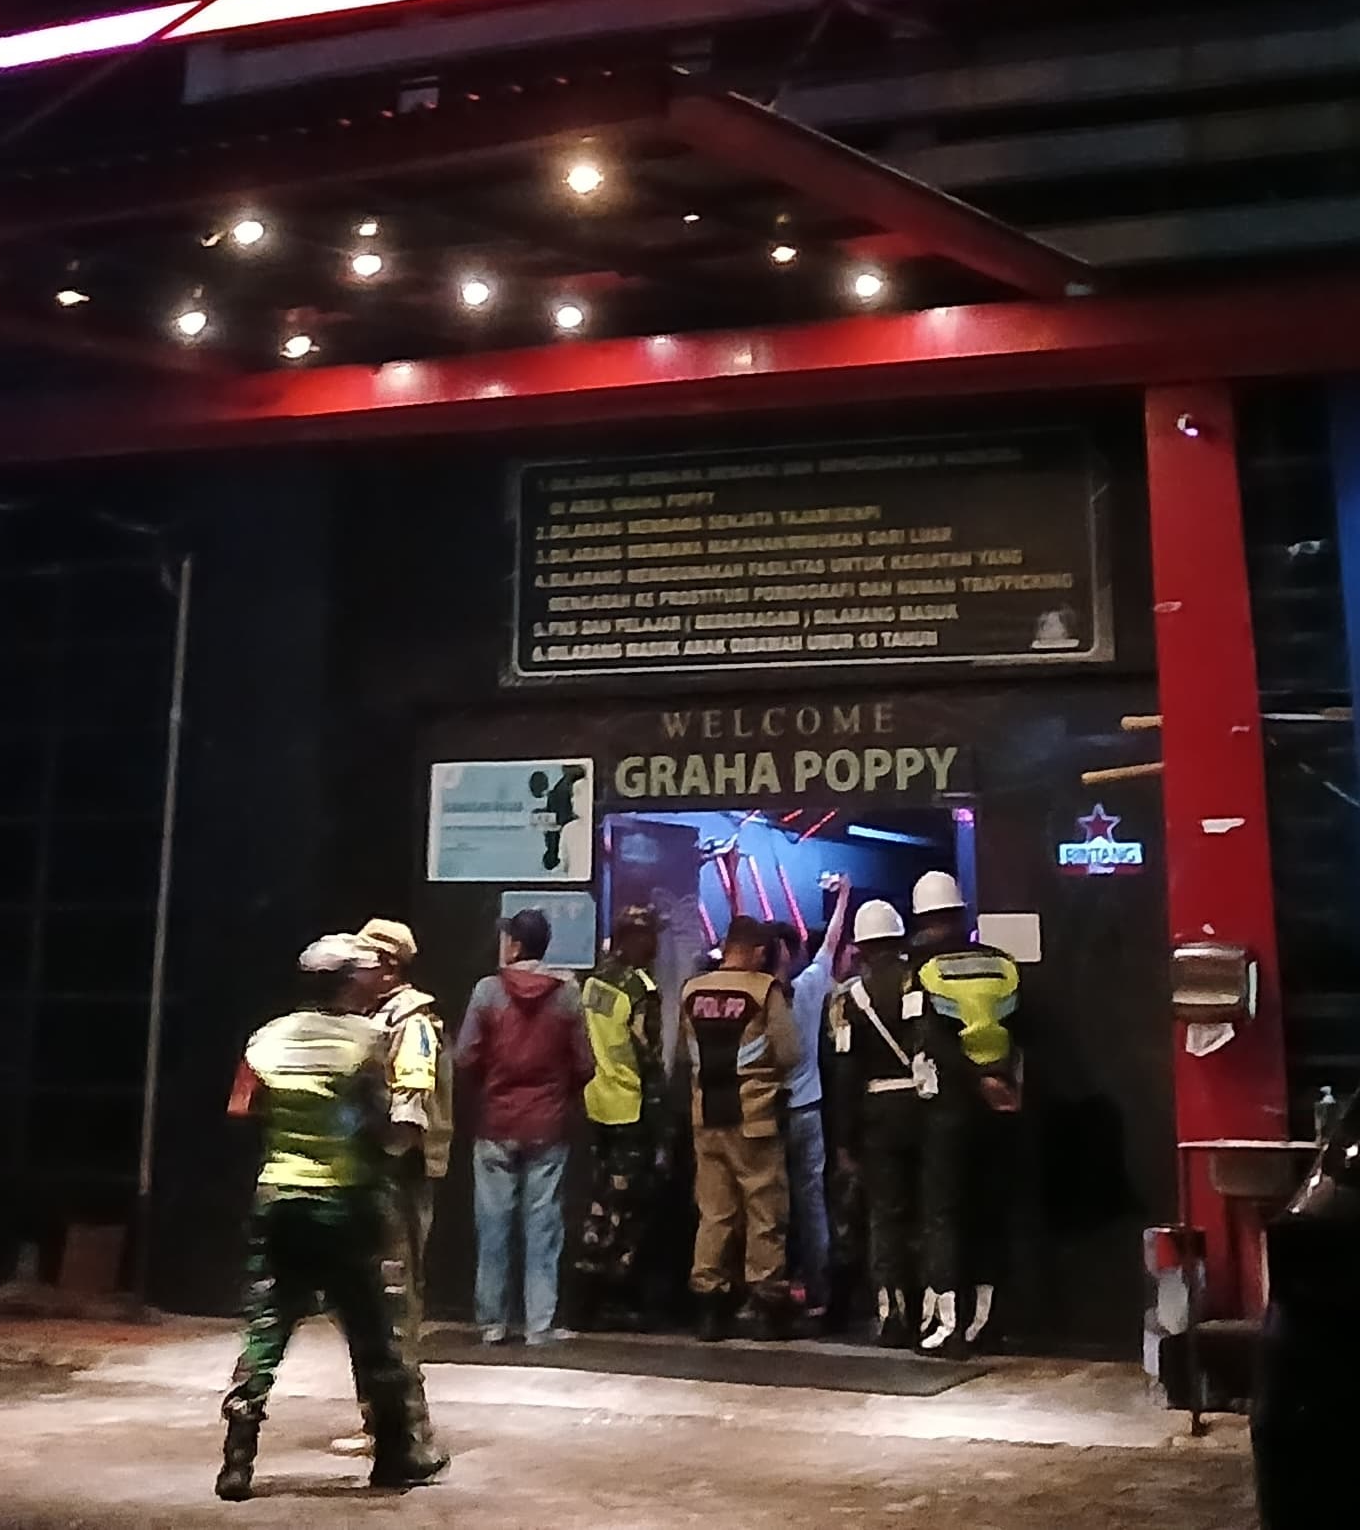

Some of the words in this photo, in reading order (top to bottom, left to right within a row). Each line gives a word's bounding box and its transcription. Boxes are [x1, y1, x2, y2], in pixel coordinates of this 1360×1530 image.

[660, 702, 896, 740] WELCOME
[614, 751, 781, 798] GRAHA
[793, 745, 958, 793] POPPY
